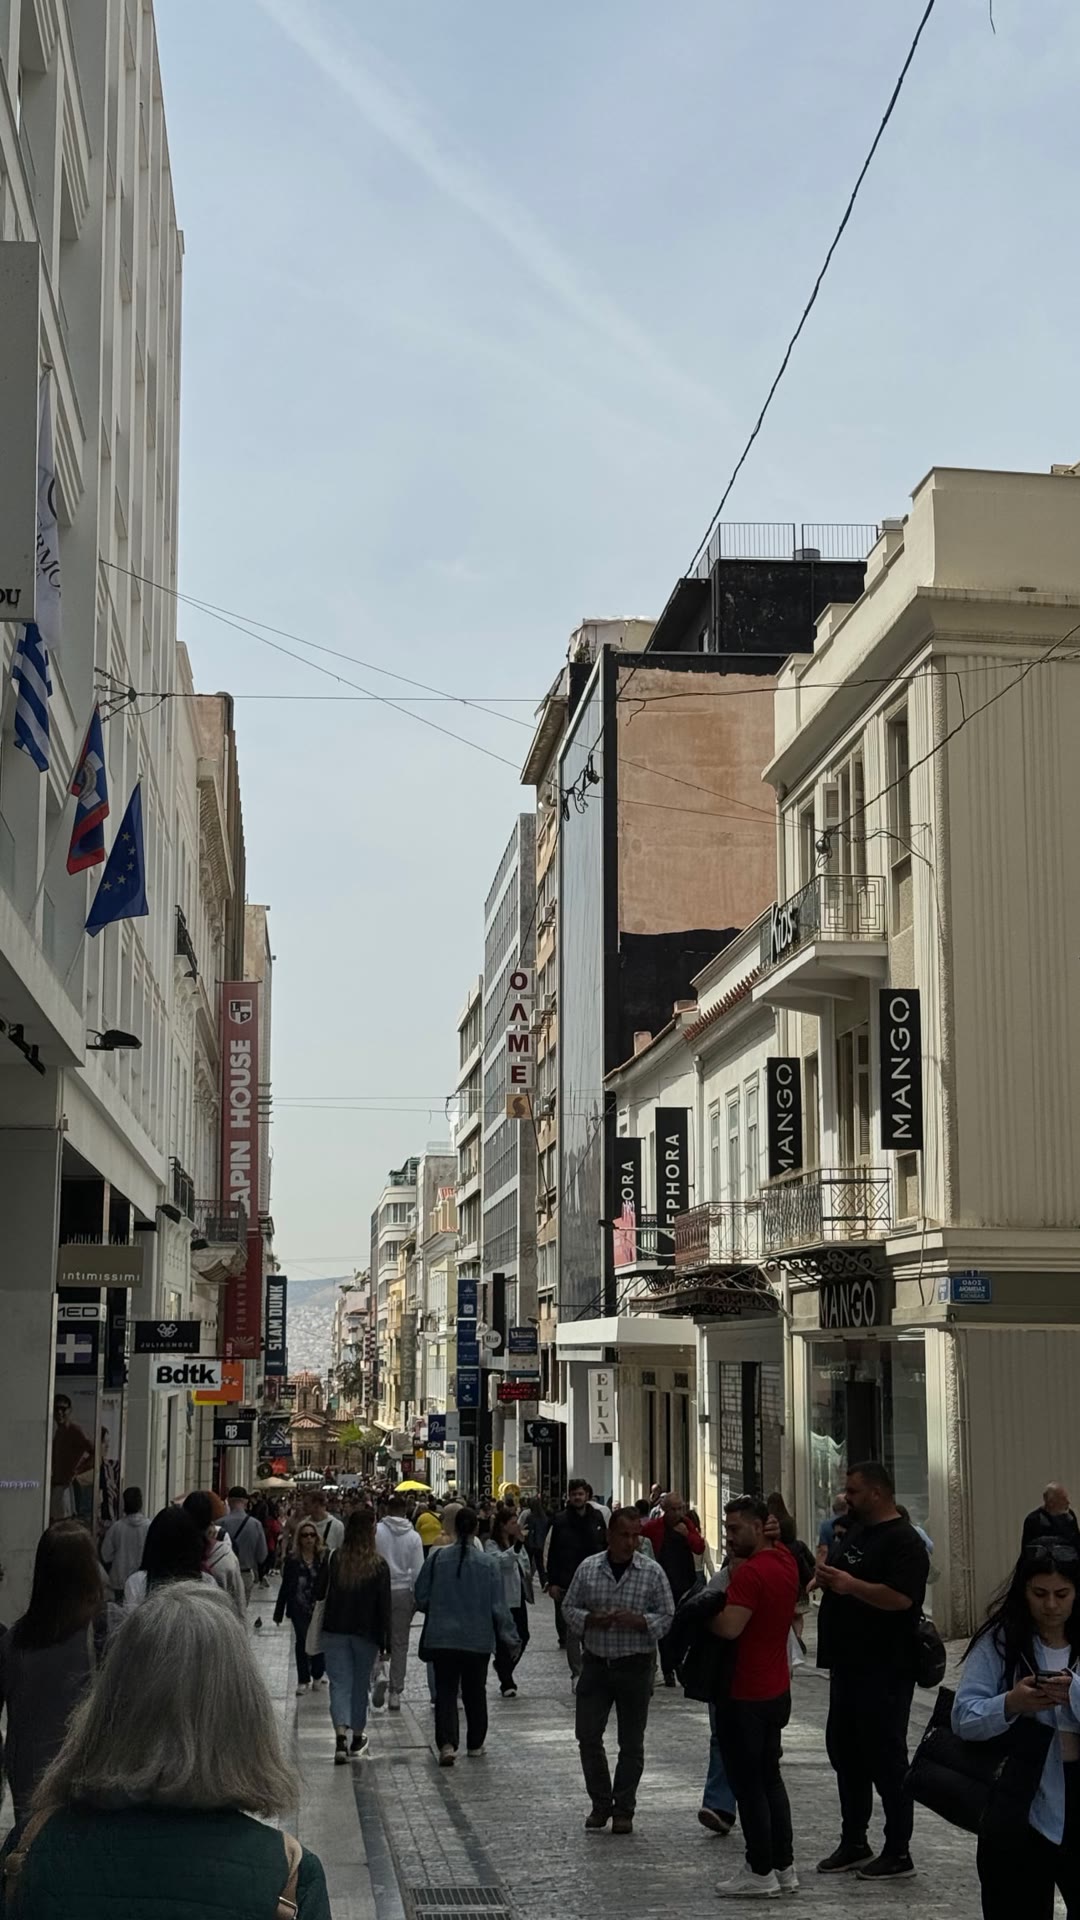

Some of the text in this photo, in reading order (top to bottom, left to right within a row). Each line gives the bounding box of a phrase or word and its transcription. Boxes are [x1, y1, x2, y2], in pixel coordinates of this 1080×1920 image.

[230, 1039, 252, 1128] HOUSE
[890, 996, 912, 1139] MANGO
[620, 1160, 635, 1200] ORA
[63, 1272, 140, 1281] intimissimi
[269, 1284, 284, 1312] DUNK
[819, 1280, 876, 1328] MANGO
[269, 1315, 282, 1351] SLAM
[157, 1364, 218, 1384] Bdtk.
[596, 1373, 610, 1434] ELLA
